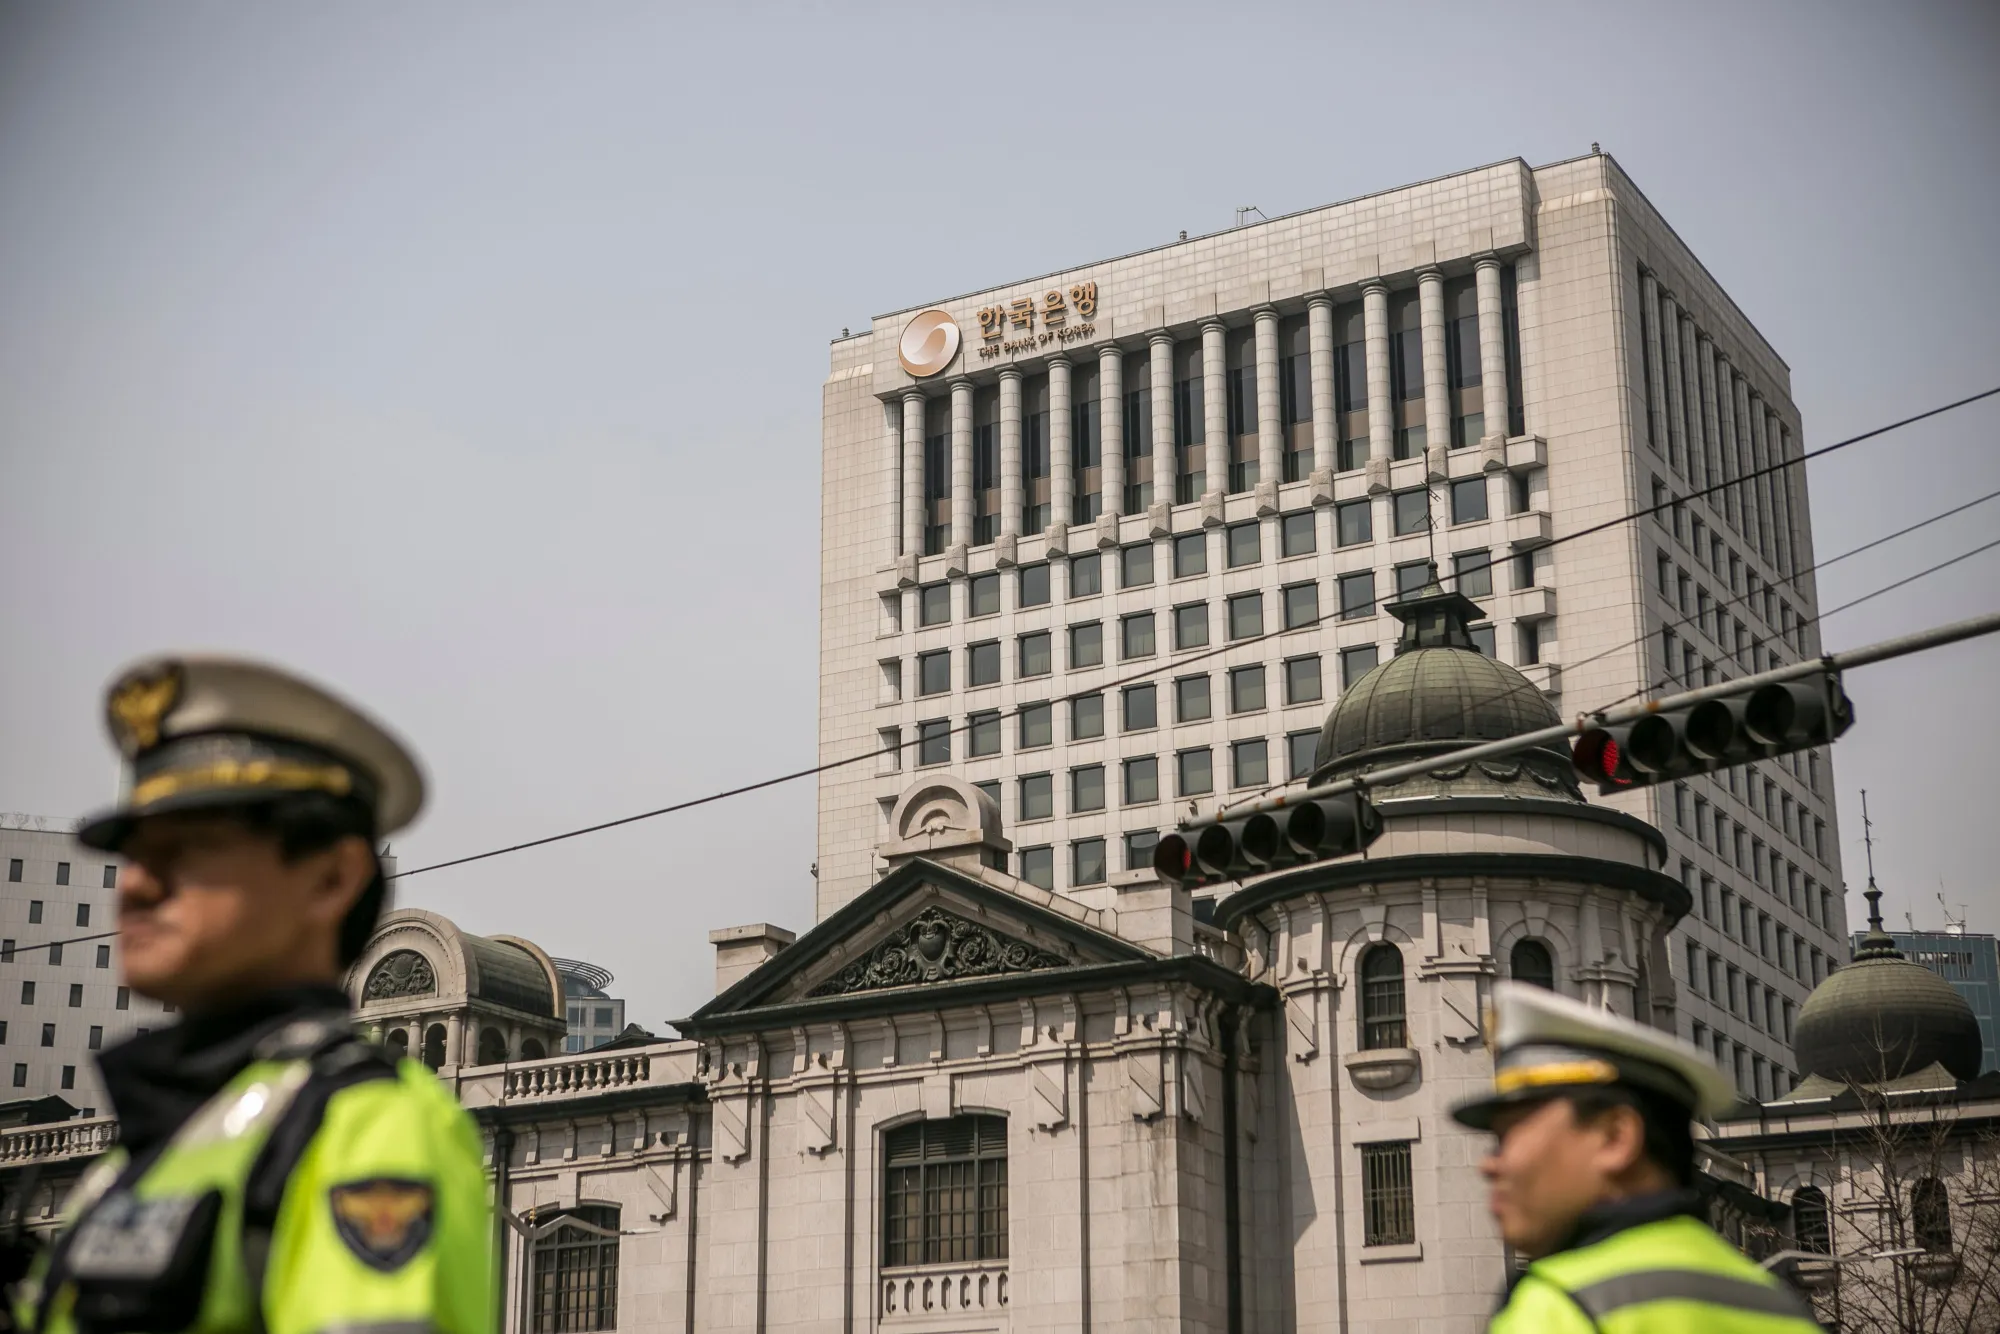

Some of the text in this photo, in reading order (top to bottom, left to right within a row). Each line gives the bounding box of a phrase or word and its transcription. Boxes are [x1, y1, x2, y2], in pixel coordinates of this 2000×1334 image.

[977, 281, 1096, 339] 한국은행
[977, 323, 1095, 357] THE BANK OF KOREA
